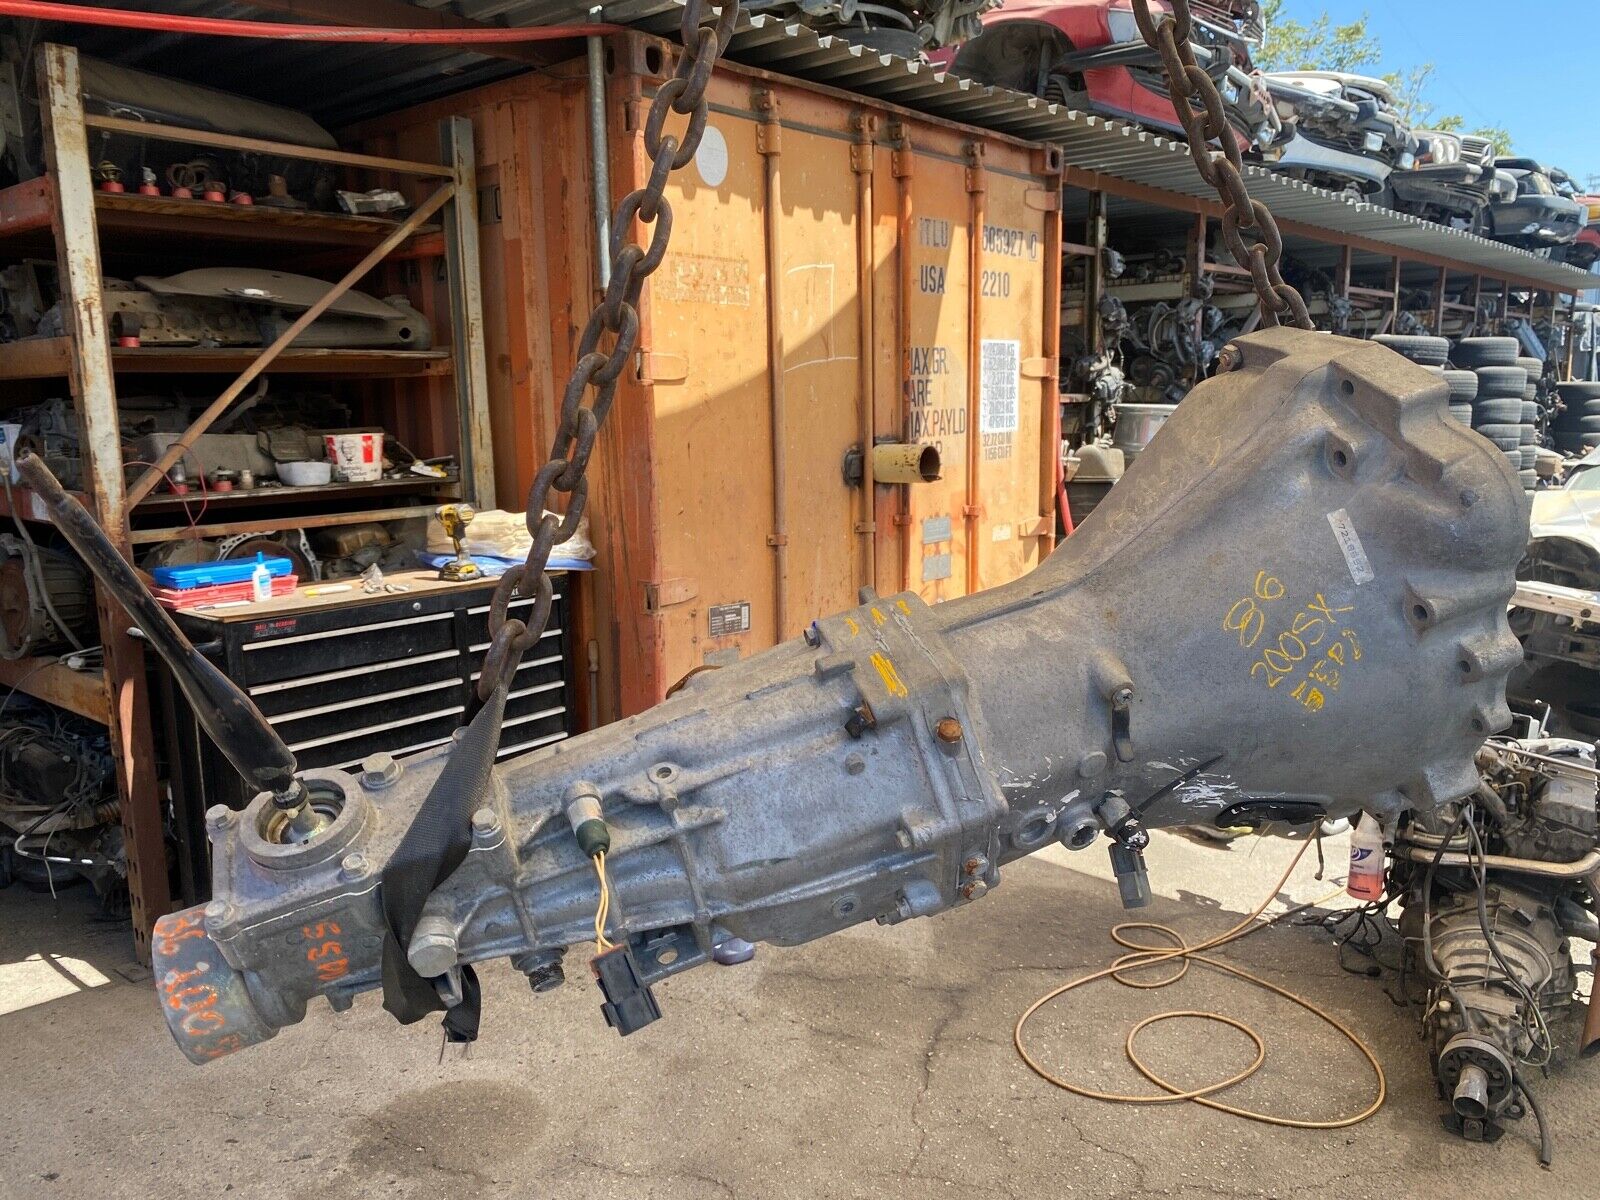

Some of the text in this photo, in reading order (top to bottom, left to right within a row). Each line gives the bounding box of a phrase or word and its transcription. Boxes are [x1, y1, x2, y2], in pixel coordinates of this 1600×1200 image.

[982, 224, 1024, 257] 605927
[920, 264, 1010, 297] USA 2210
[1223, 570, 1286, 647] 86
